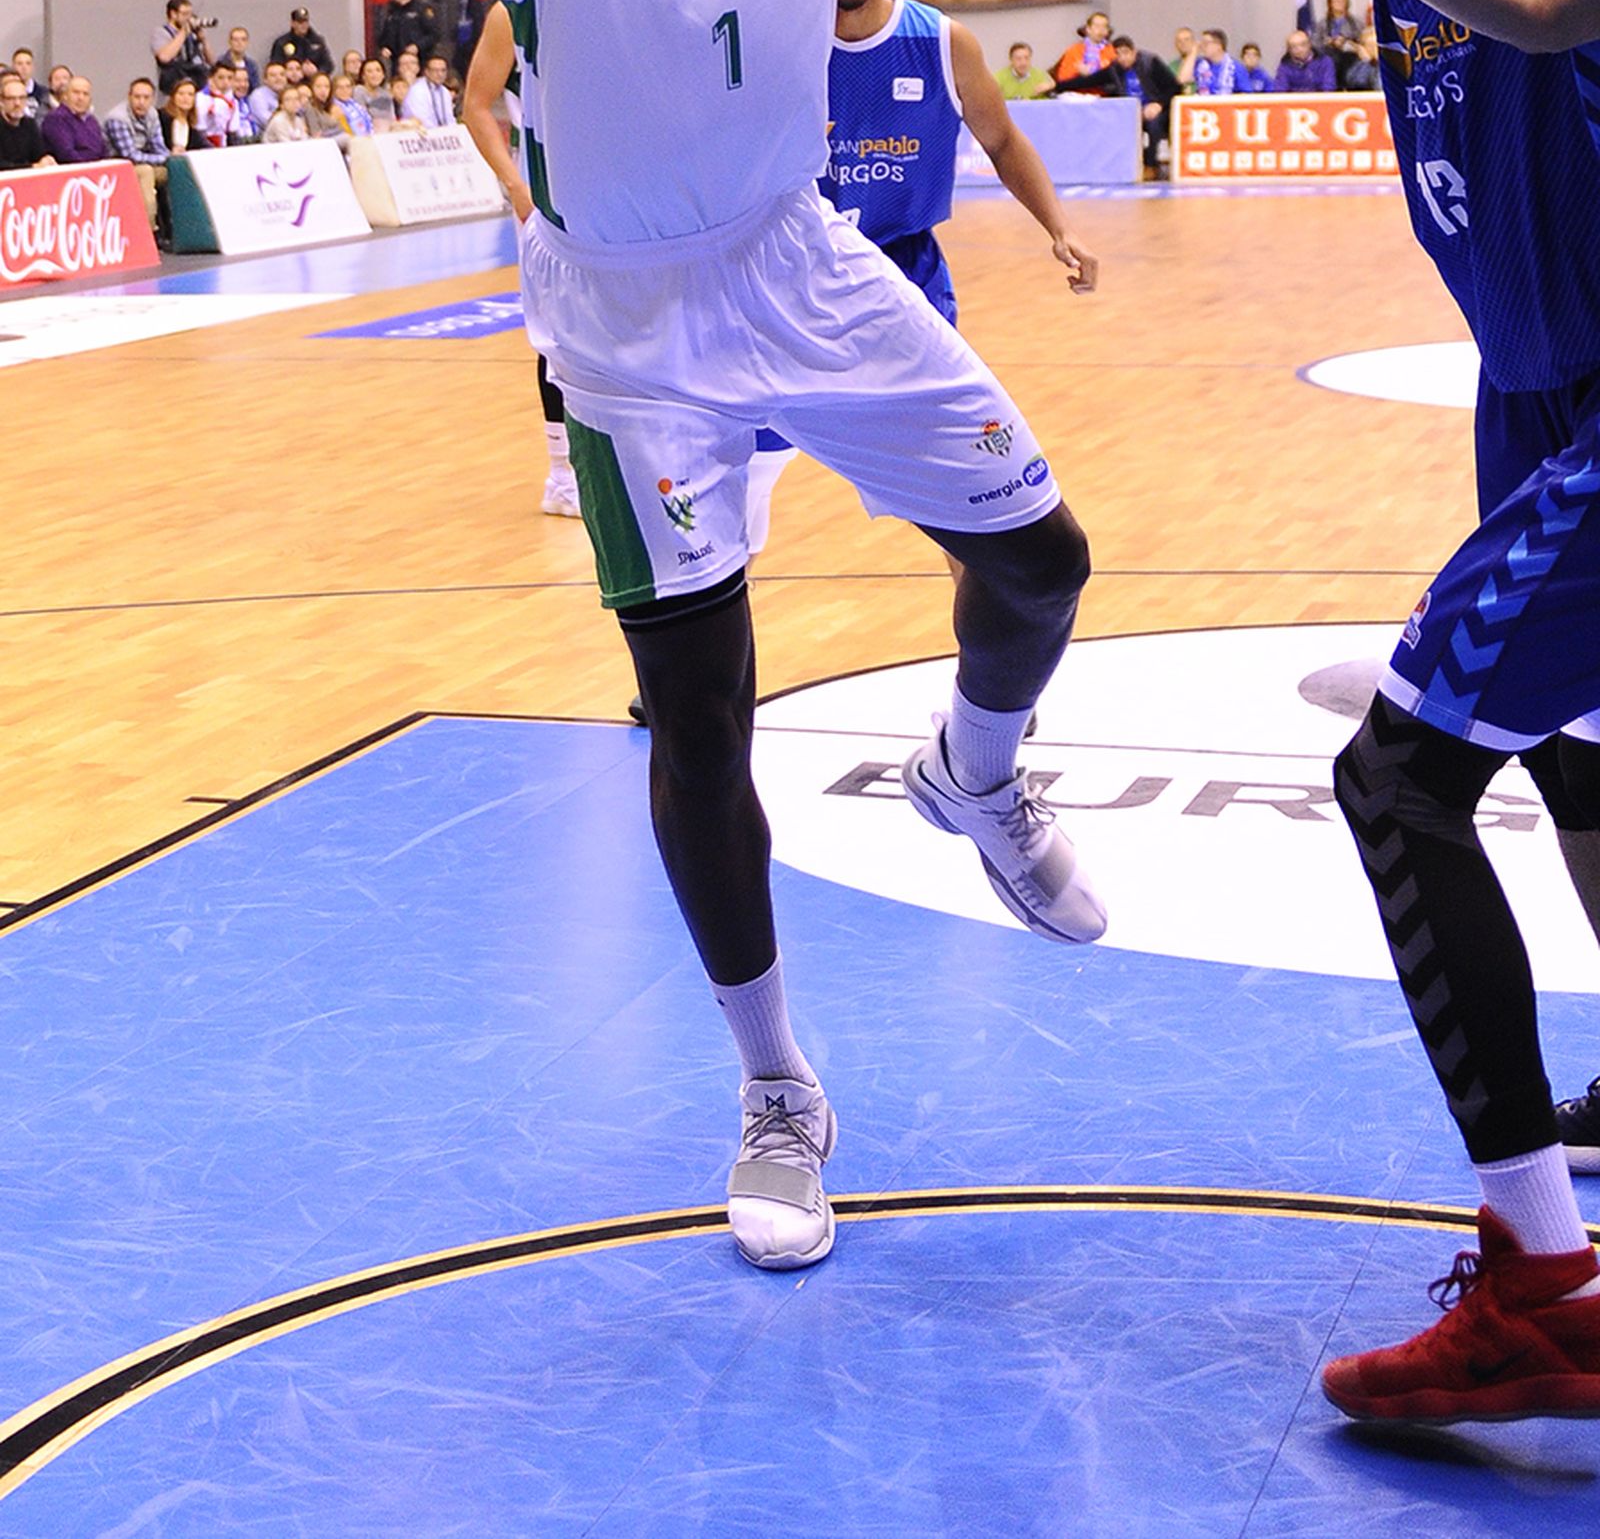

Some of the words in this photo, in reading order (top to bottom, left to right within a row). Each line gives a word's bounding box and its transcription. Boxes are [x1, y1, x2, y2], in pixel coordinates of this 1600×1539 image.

[711, 10, 743, 91] 1
[1189, 107, 1393, 144] BURG
[828, 162, 904, 185] URGOS
[1416, 159, 1469, 236] 13
[0, 174, 130, 282] Coca-Cola
[1025, 460, 1047, 485] plus
